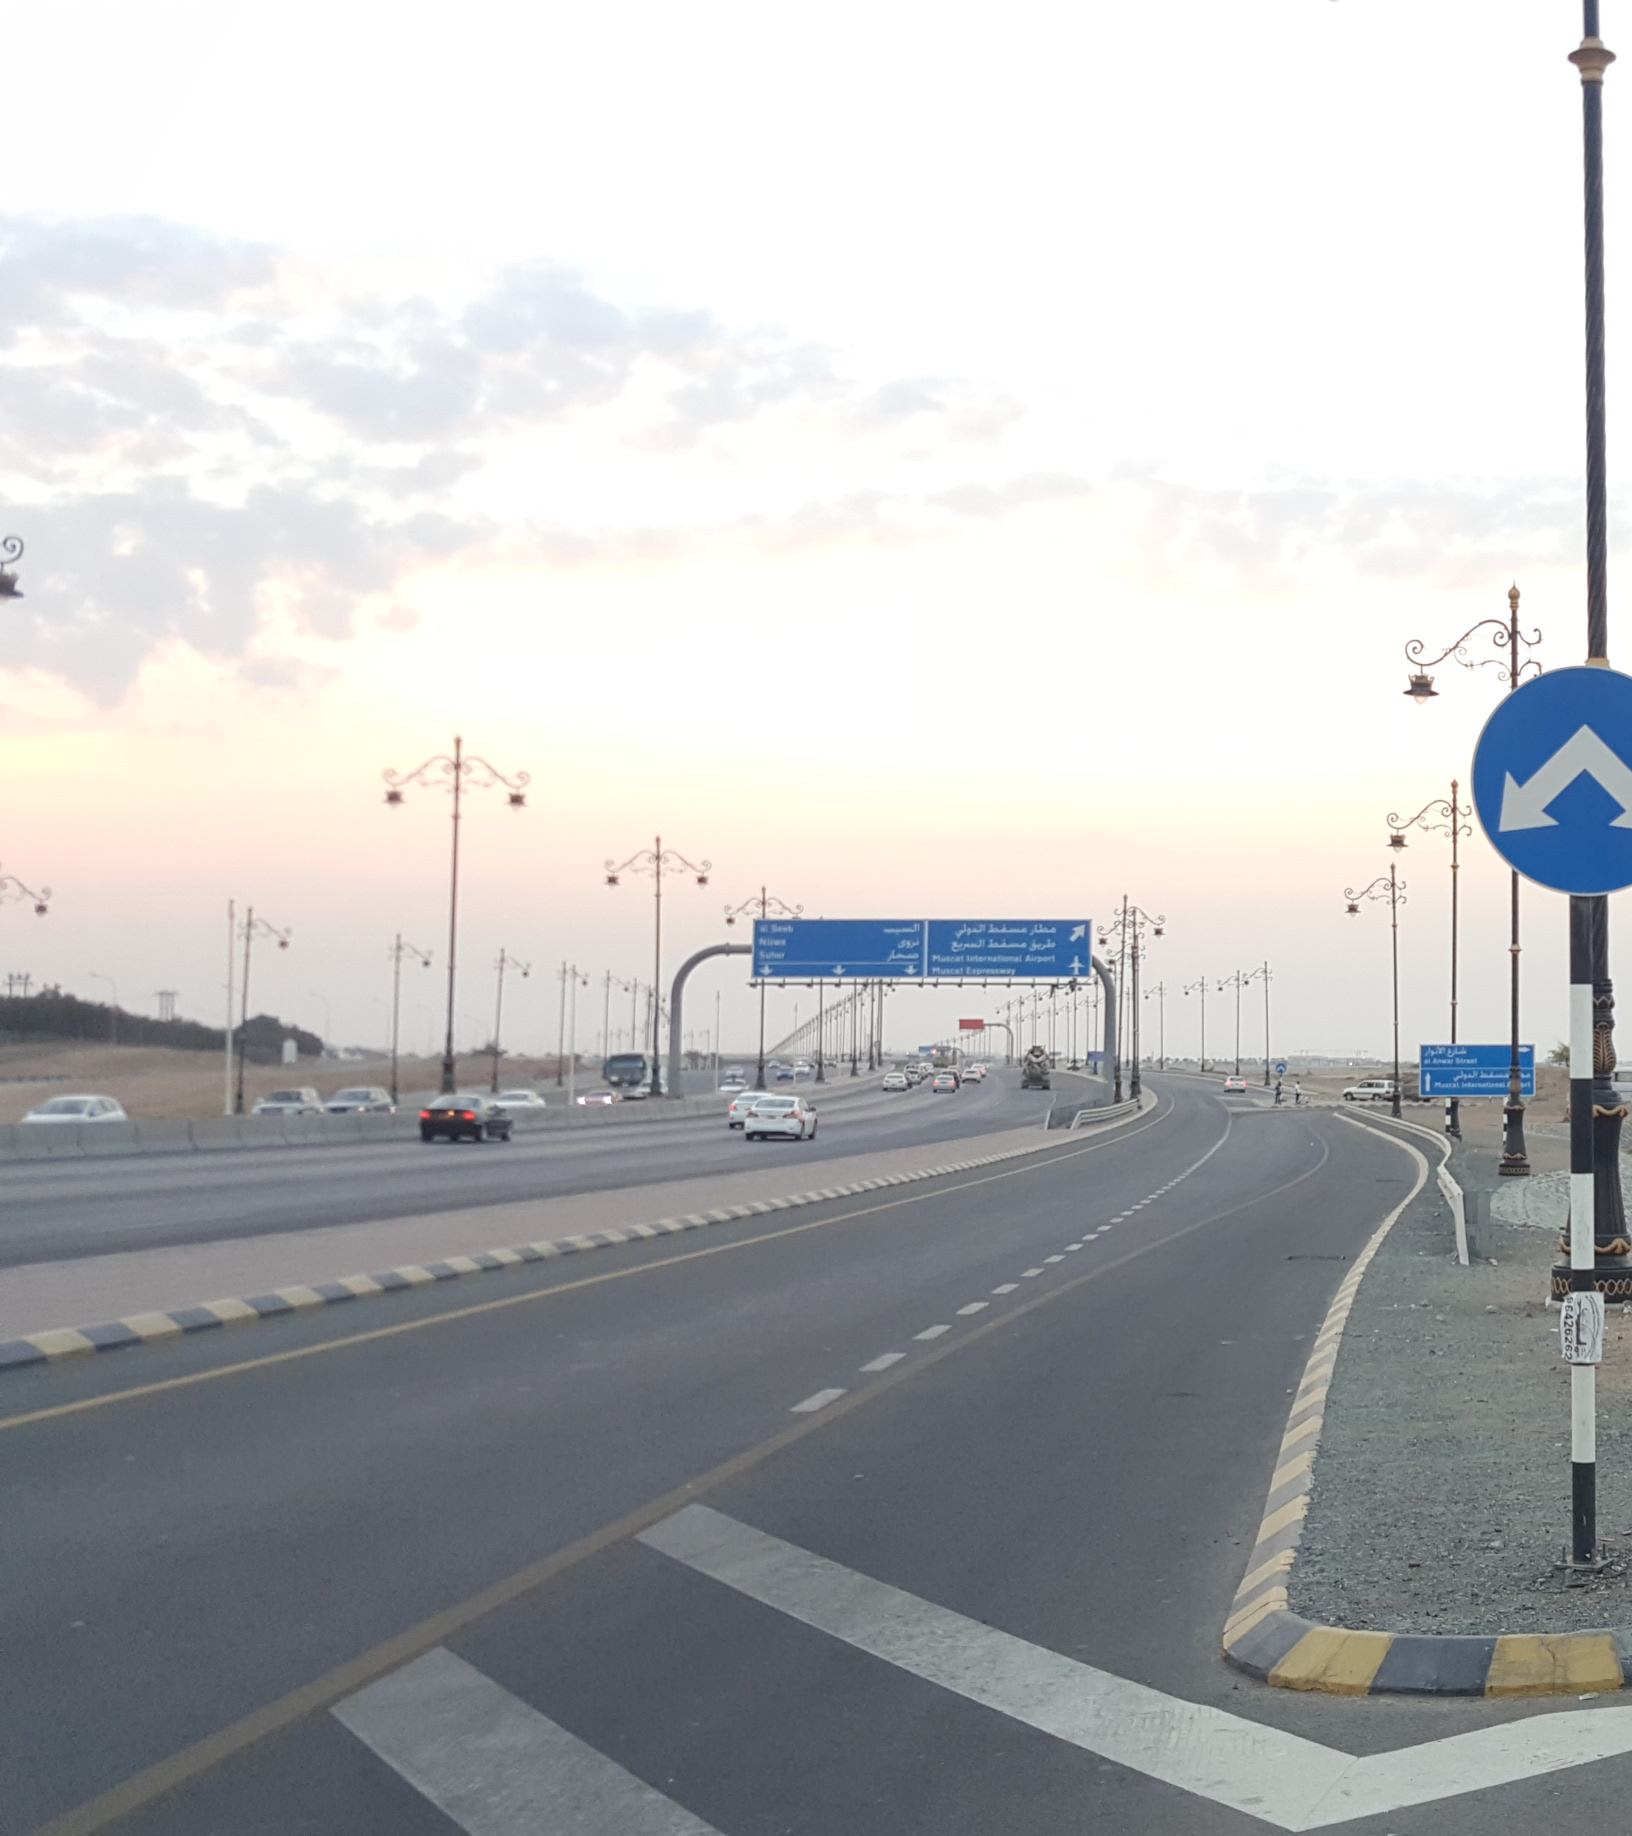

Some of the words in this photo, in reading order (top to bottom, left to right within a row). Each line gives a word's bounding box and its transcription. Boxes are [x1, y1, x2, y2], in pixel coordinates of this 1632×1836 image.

[771, 924, 794, 933] Seeb
[883, 923, 921, 935] السيب
[954, 923, 986, 938] الدولي
[987, 923, 1027, 934] مسقط
[1029, 923, 1057, 937] مطار
[951, 939, 985, 952] السريع
[987, 939, 1027, 949] مسقط
[1029, 940, 1057, 951] طريق
[931, 954, 965, 963] Muscat
[966, 954, 1022, 963] International
[1024, 954, 1056, 964] Airport
[931, 967, 964, 975] Muscat
[966, 967, 1016, 976] Expressway
[1446, 1046, 1467, 1058] شارع
[1453, 1070, 1478, 1082] الدولي
[1434, 1081, 1460, 1089] Muscat
